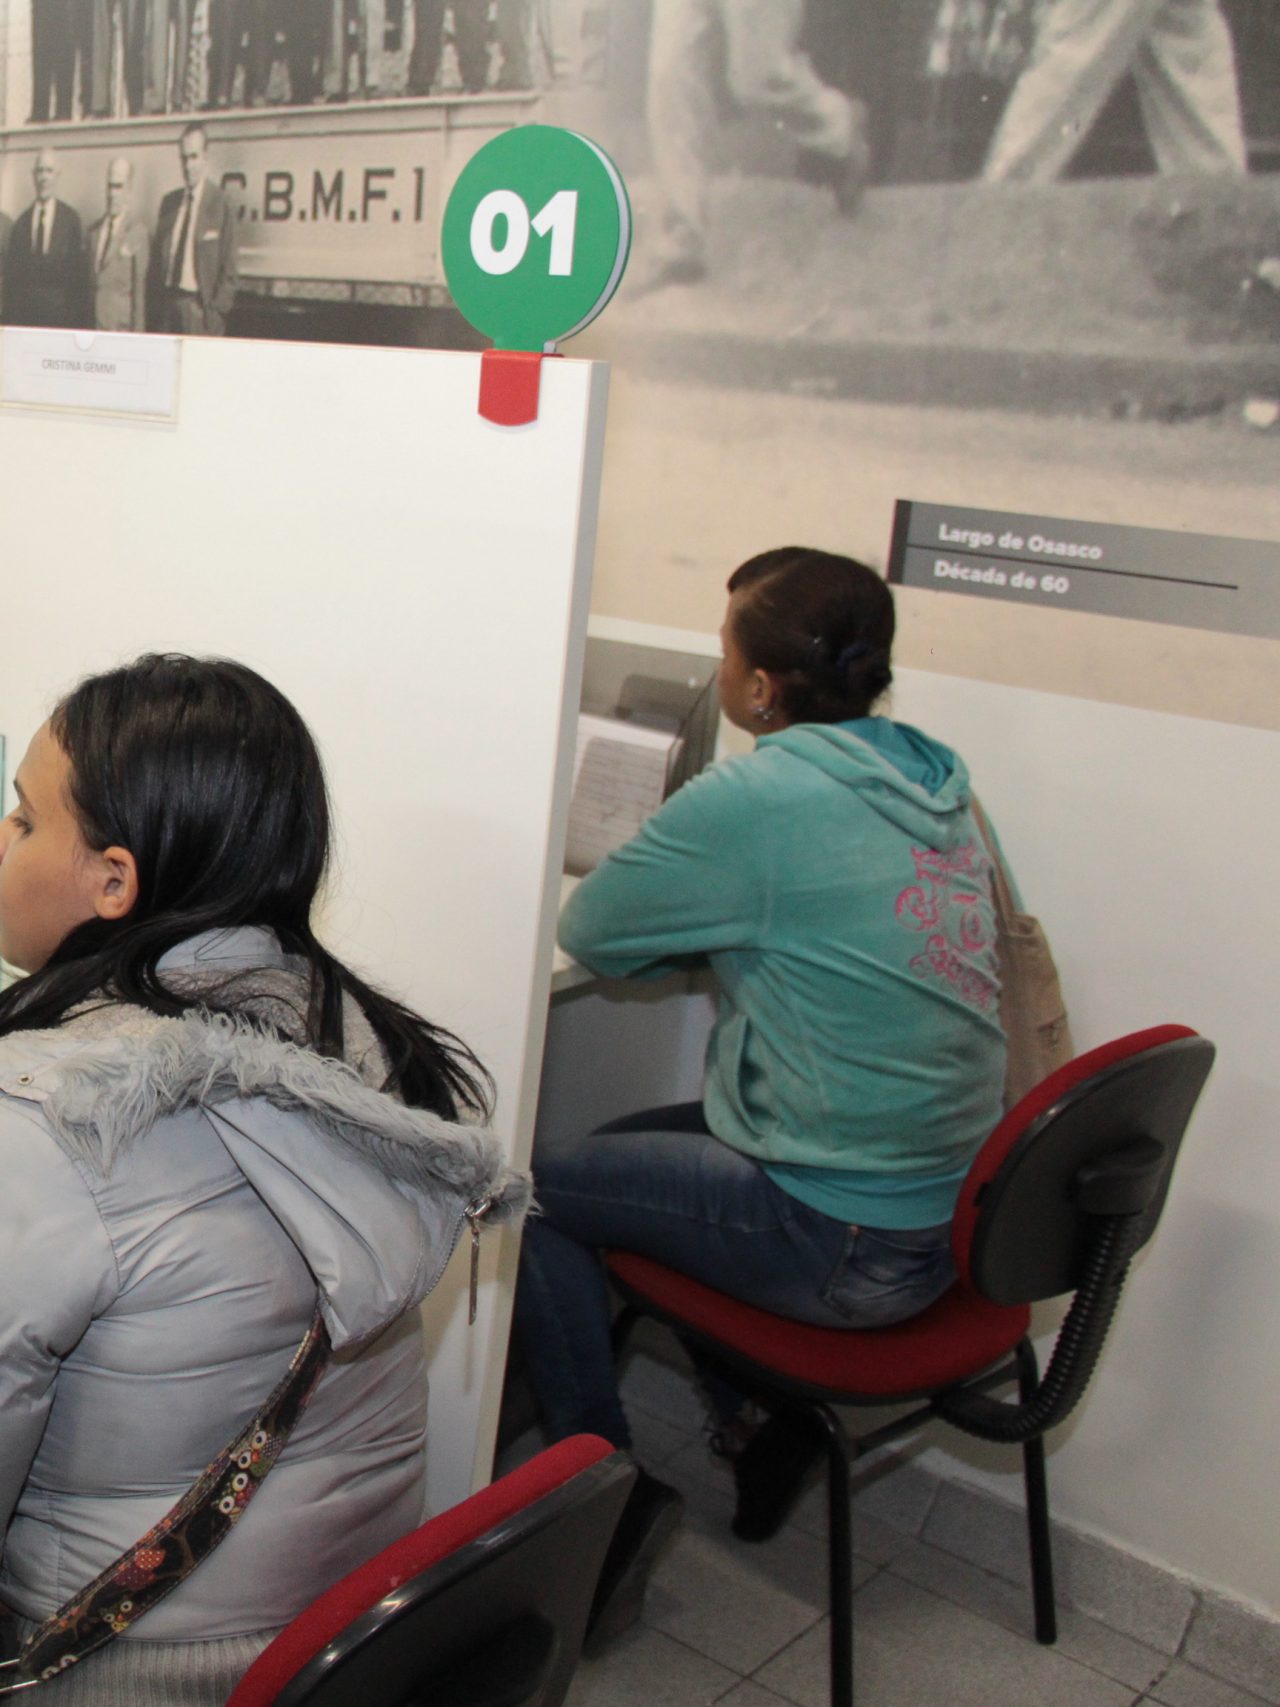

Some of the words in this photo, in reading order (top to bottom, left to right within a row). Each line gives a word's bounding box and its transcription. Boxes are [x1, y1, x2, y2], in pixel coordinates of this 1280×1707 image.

[469, 189, 578, 277] 01
[938, 523, 994, 548] Largo
[998, 532, 1024, 550] de
[1028, 535, 1102, 560] Osasco
[934, 560, 1006, 586] Década
[1011, 572, 1036, 589] de
[1040, 574, 1069, 594] 60
